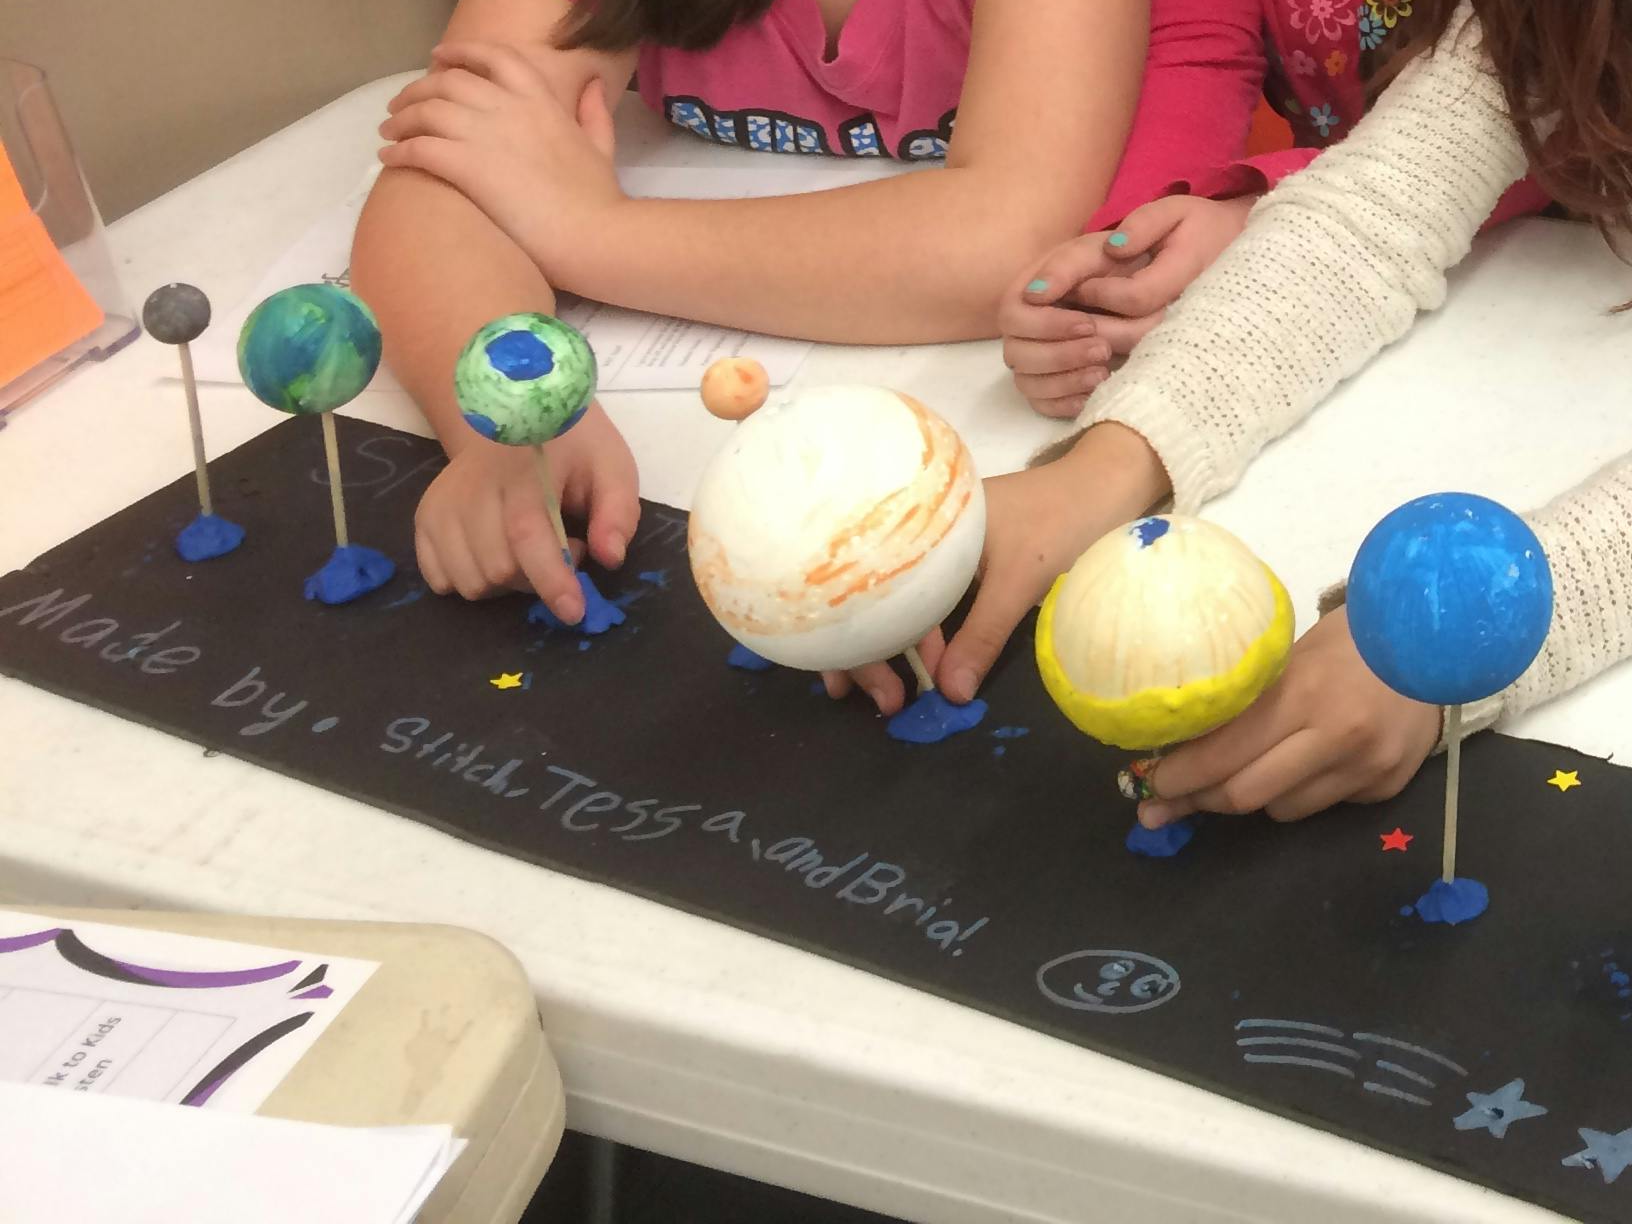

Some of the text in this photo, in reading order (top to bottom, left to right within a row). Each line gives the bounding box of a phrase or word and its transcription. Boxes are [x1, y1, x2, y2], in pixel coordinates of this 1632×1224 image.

[1, 588, 201, 674] Made
[763, 836, 869, 889] and
[63, 1050, 87, 1069] to
[82, 1015, 123, 1048] Kids
